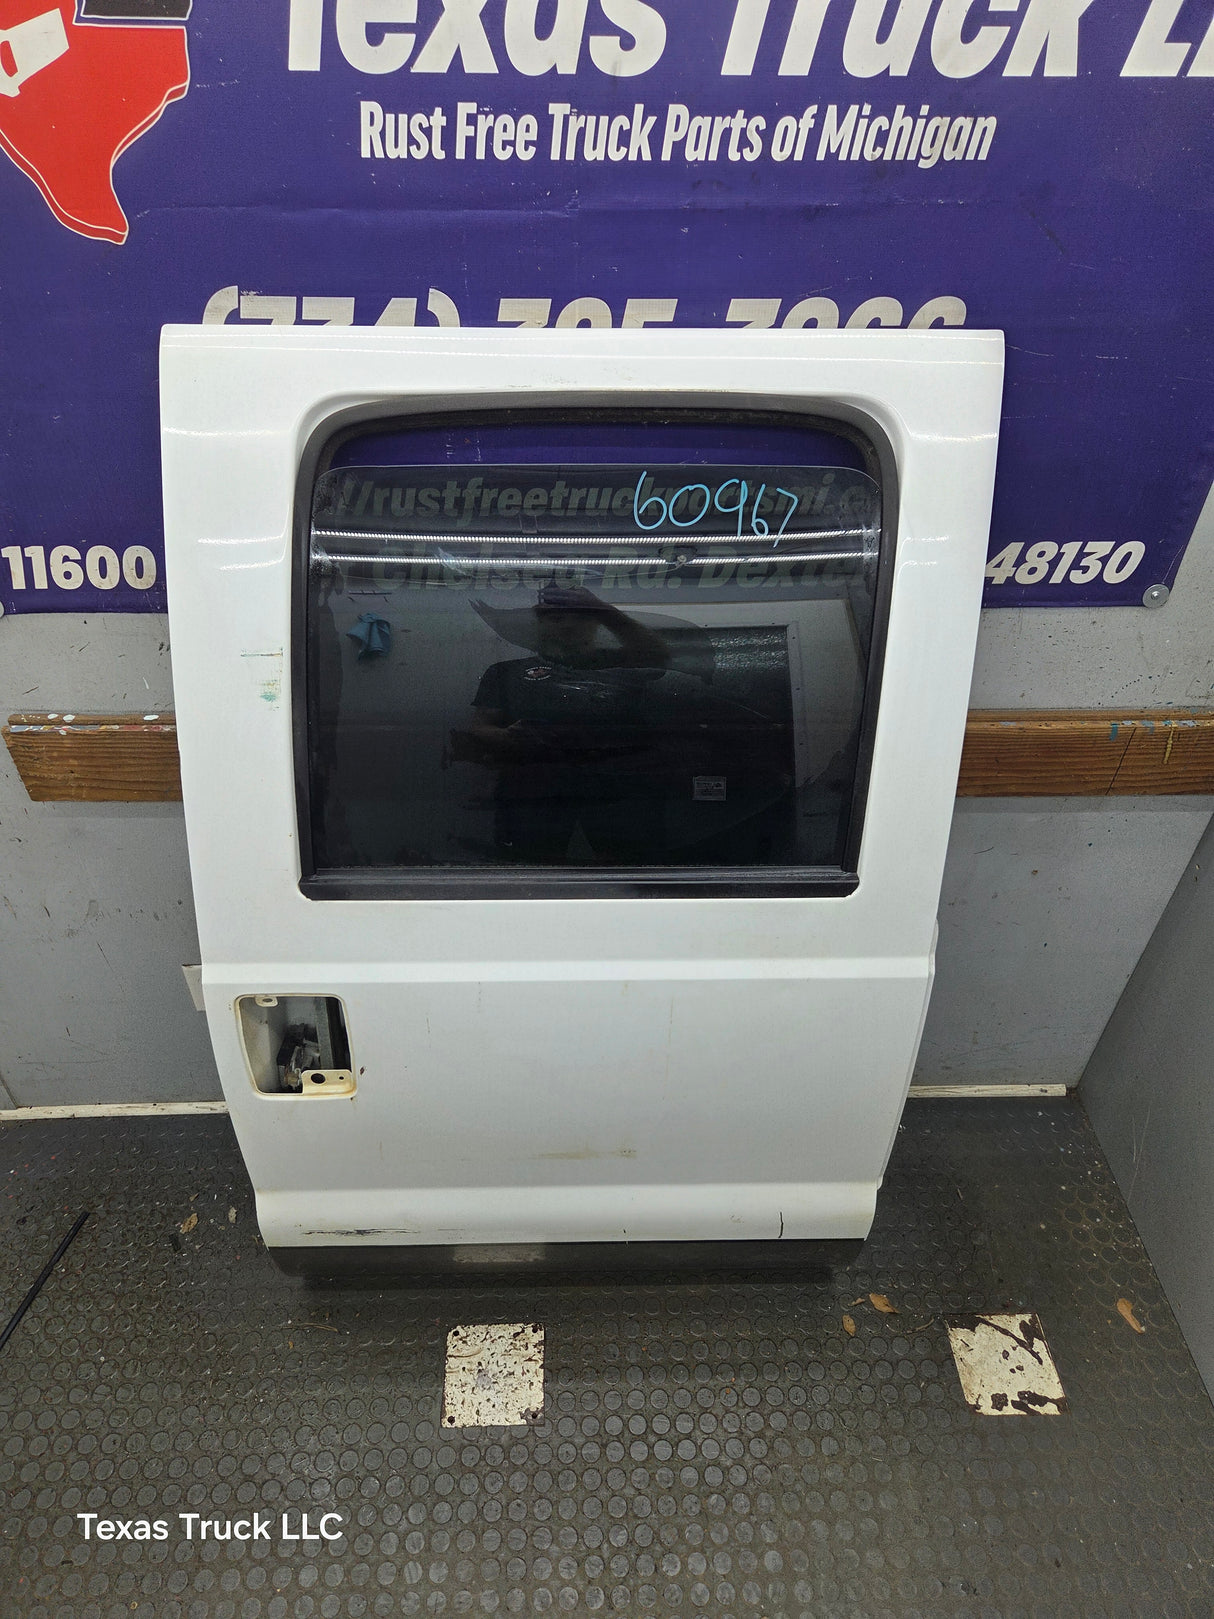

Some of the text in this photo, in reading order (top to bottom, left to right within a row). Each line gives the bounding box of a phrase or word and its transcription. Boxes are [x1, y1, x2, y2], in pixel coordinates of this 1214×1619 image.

[360, 101, 997, 169] Rust Free Truck Parts of Michigan
[633, 471, 799, 548] 60967
[1, 545, 156, 590] 11600
[600, 544, 683, 590] Rd.
[984, 540, 1146, 585] 48130
